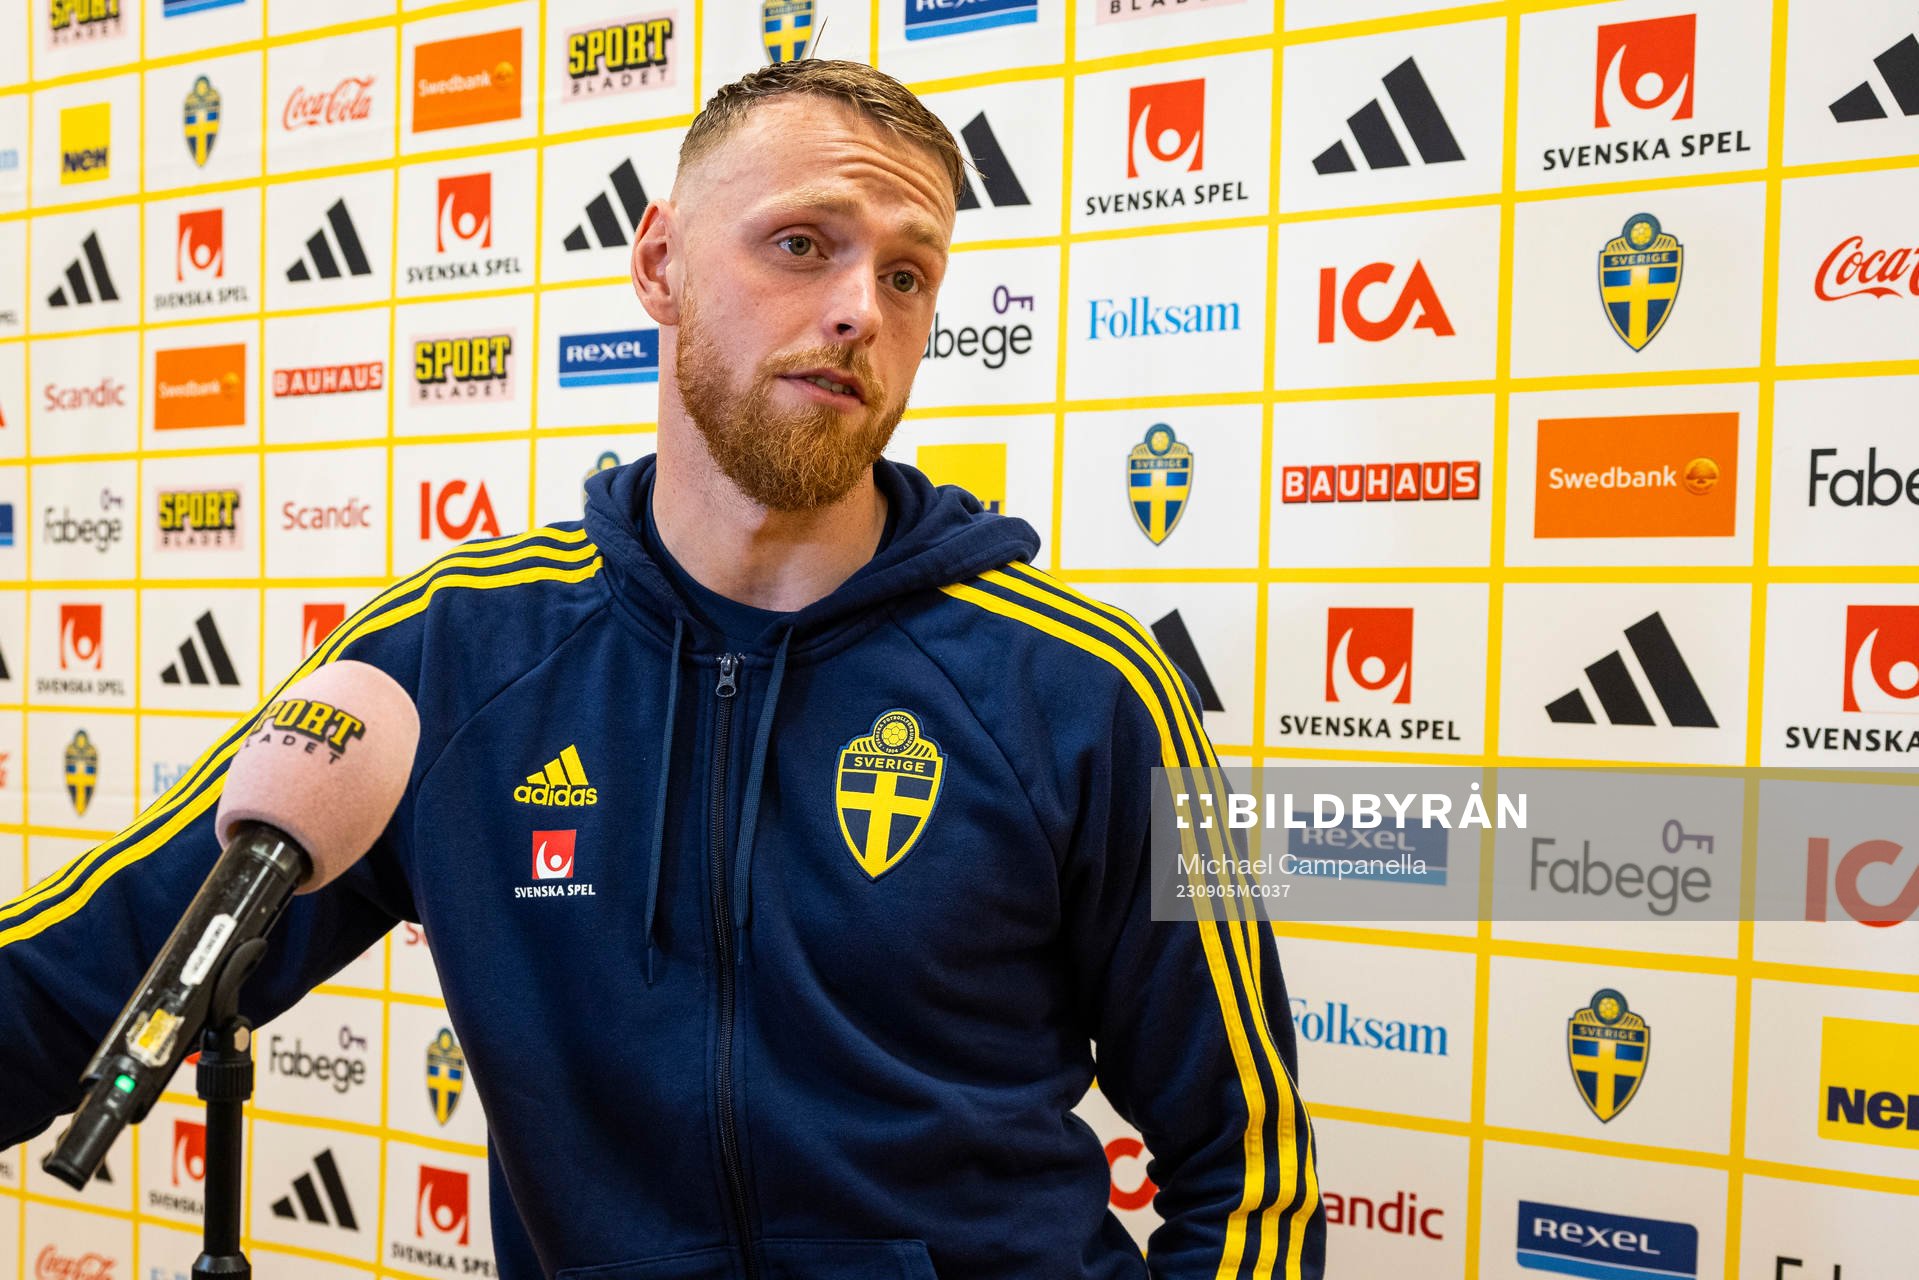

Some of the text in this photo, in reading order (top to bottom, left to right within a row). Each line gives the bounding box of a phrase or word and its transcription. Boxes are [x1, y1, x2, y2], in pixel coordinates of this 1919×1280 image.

[568, 18, 673, 79] SPORT
[418, 71, 491, 97] Swedbank
[571, 68, 667, 95] BLADET
[1543, 130, 1751, 171] SVENSKA SPEL
[1086, 181, 1249, 216] SVENSKA SPEL
[406, 258, 522, 284] SVENSKA SPEL
[1610, 252, 1670, 266] SVERIGE
[1087, 296, 1241, 340] Folksam
[1318, 258, 1456, 343] ICA
[921, 312, 1033, 370] bege
[415, 335, 512, 384] SPORT
[44, 378, 125, 412] Scandic
[275, 361, 384, 398] BAUHAUS
[1284, 464, 1477, 499] BAUHAUS
[1549, 465, 1677, 490] Swedbank
[159, 490, 240, 531] SPORT
[282, 498, 370, 530] Scandic
[420, 480, 501, 540] ICA
[44, 504, 122, 553] Fabege
[1279, 714, 1462, 742] SVENSKA SPEL
[1785, 725, 1919, 753] SVENSKA
[854, 756, 925, 773] SVERIGE
[513, 783, 598, 807] adidas
[514, 884, 596, 898] SVENSKA SPEL
[1530, 836, 1713, 917] Fabege
[1805, 836, 1919, 928] IC
[1579, 1025, 1637, 1042] SVERIGE
[270, 1035, 366, 1094] Fabege
[1322, 1191, 1445, 1242] andic
